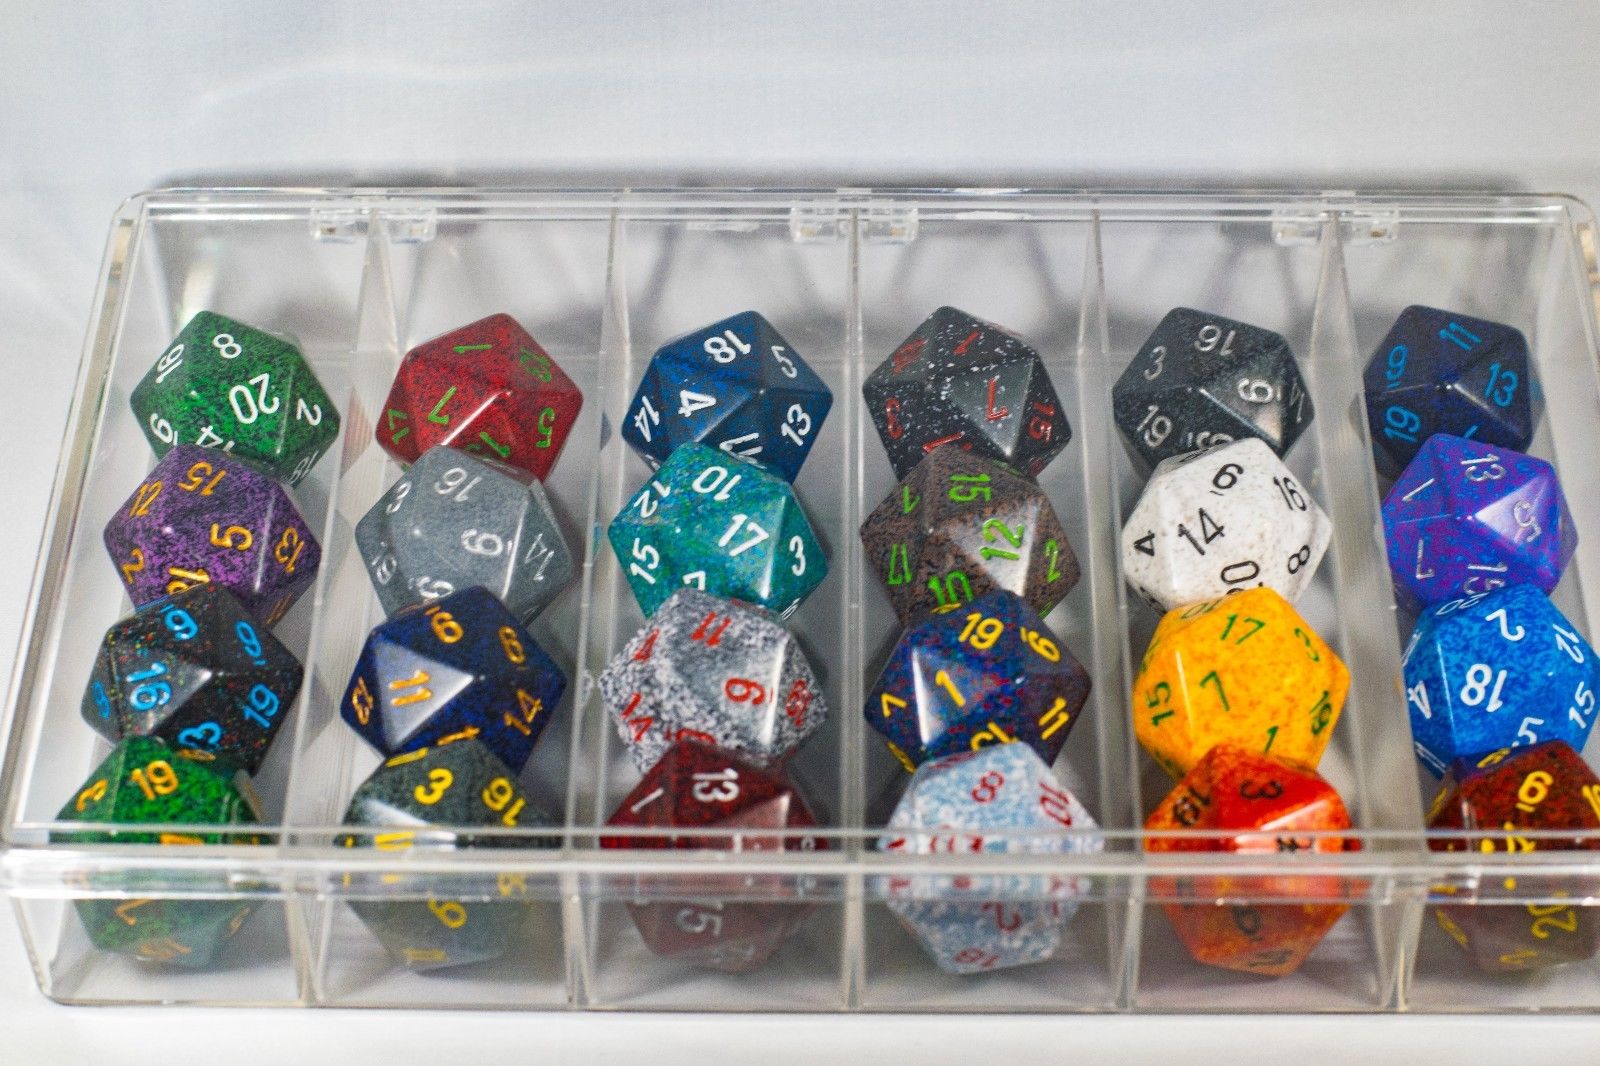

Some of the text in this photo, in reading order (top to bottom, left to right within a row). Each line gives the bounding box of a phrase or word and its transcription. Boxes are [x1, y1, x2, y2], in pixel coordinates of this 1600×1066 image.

[212, 333, 242, 359] 8
[703, 330, 751, 363] 18
[1194, 324, 1237, 356] 16
[1439, 321, 1482, 351] 11
[1144, 345, 1167, 380] 3
[229, 373, 279, 424] 20
[678, 390, 717, 417] 4
[985, 377, 1009, 422] 7
[1483, 361, 1518, 408] 13
[296, 398, 322, 426] 2
[427, 386, 457, 424] 7
[634, 396, 660, 442] 14
[1384, 404, 1421, 443] 19
[535, 408, 555, 448] 5
[781, 403, 811, 446] 13
[177, 461, 227, 496] 15
[692, 466, 741, 501] 10
[1460, 453, 1506, 482] 13
[634, 480, 671, 518] 12
[948, 473, 992, 503] 15
[209, 522, 254, 550] 5
[274, 526, 304, 574] 13
[718, 513, 769, 557] 17
[979, 518, 1025, 560] 12
[1134, 530, 1156, 557] 4
[1178, 507, 1225, 555] 14
[122, 547, 145, 585] 2
[525, 533, 555, 581] 14
[630, 537, 660, 585] 15
[789, 535, 806, 577] 3
[1045, 539, 1062, 583] 2
[1287, 545, 1311, 574] 8
[1415, 539, 1435, 580] 7
[691, 611, 731, 647] 11
[958, 612, 1004, 650] 19
[1220, 614, 1265, 645] 17
[1484, 608, 1526, 642] 2
[1552, 623, 1585, 664] 12
[126, 662, 172, 711] 16
[243, 683, 280, 728] 19
[389, 669, 432, 707] 11
[881, 693, 907, 717] 7
[935, 670, 966, 707] 1
[1145, 681, 1175, 726] 15
[1199, 670, 1230, 712] 7
[1407, 680, 1432, 720] 4
[1460, 663, 1507, 712] 18
[1568, 681, 1596, 729] 15
[504, 689, 543, 736] 14
[1038, 696, 1070, 740] 11
[177, 721, 222, 750] 3
[130, 760, 179, 800] 19
[414, 768, 454, 805] 3
[692, 768, 740, 802] 13
[971, 771, 1004, 803] 8
[1240, 780, 1283, 799] 3
[482, 777, 526, 827] 16
